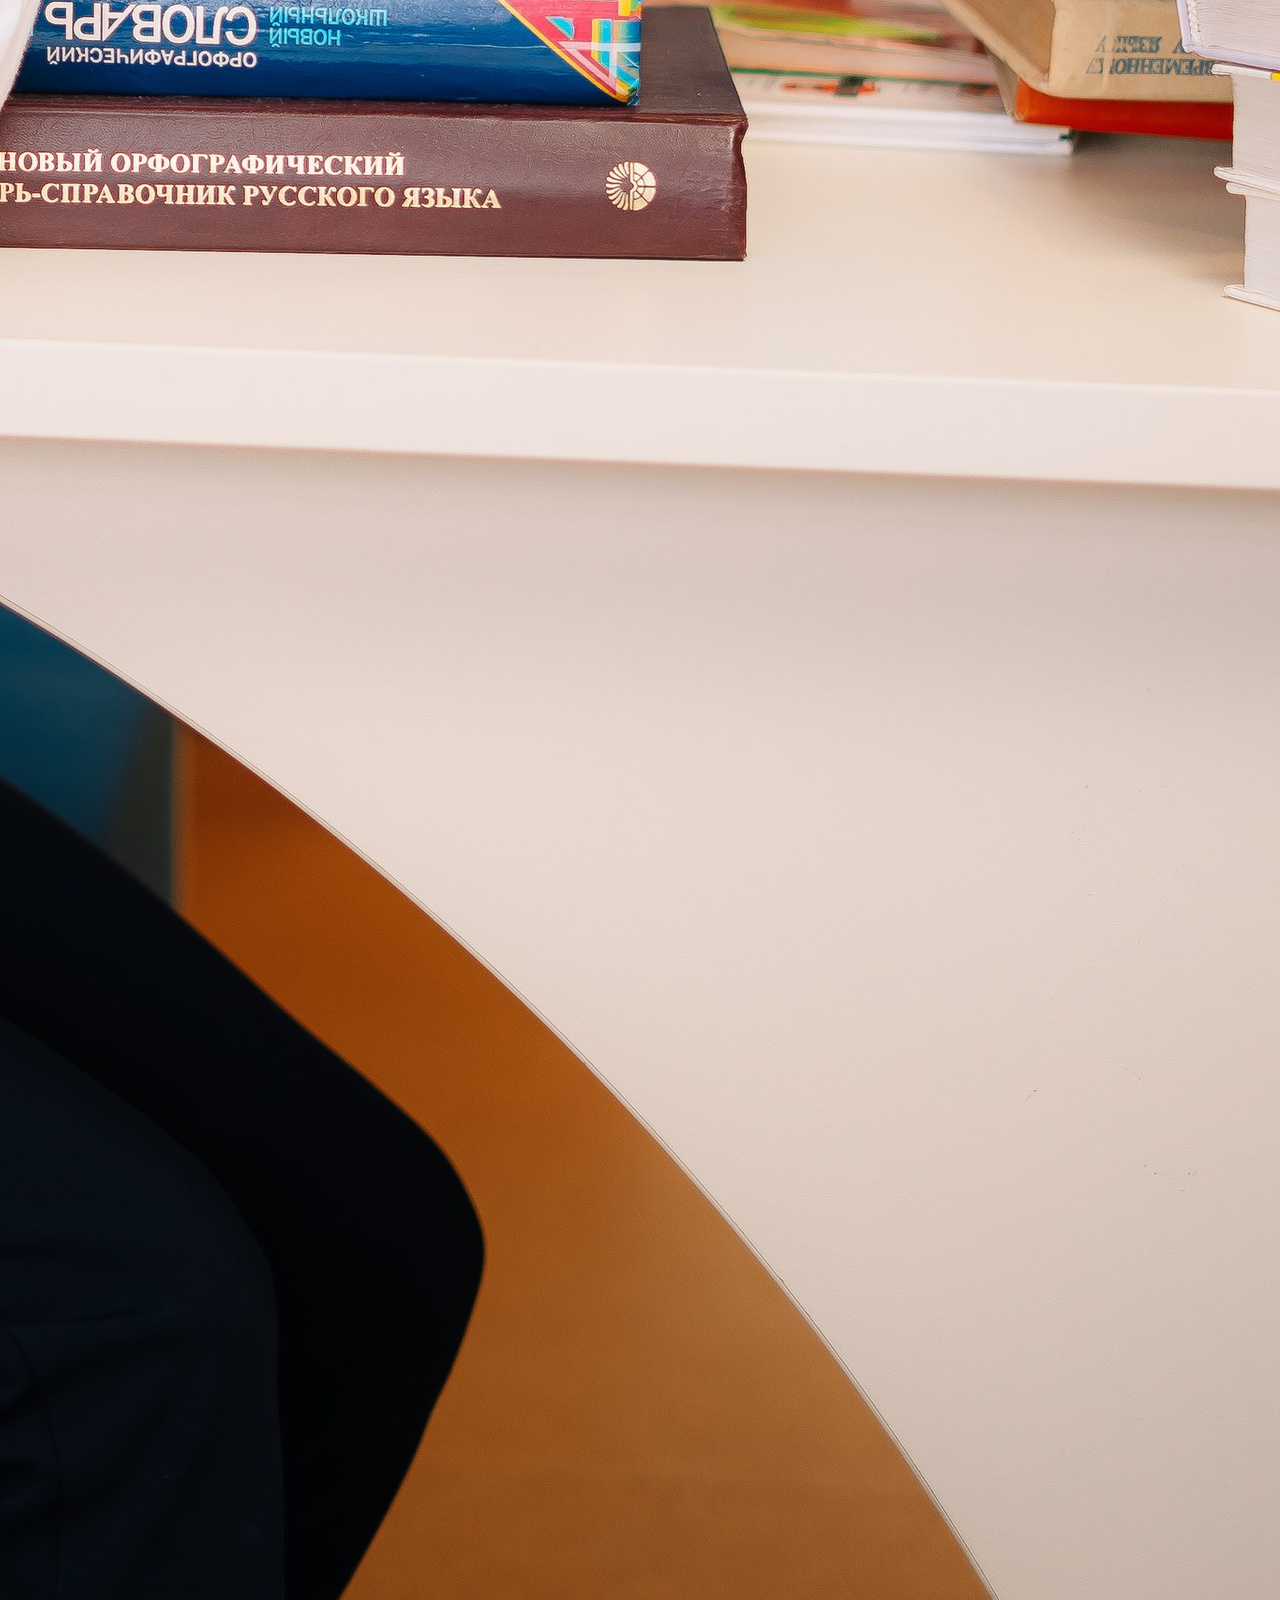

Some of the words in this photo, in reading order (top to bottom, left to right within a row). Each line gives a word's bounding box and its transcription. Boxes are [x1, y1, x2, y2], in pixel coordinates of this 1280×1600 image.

[44, 1, 258, 47] СЛОВАРЬ
[269, 6, 388, 27] ШКОЛЬНЫЙ
[269, 27, 342, 48] НОВЫЙ
[46, 46, 258, 69] ОРФОГРАФИЧЕСКИЙ
[111, 152, 405, 178] ОРФОГРАФИЧЕСКИЙ
[242, 185, 395, 209] РУССКОГО
[402, 187, 502, 211] ЯЗЫКА
